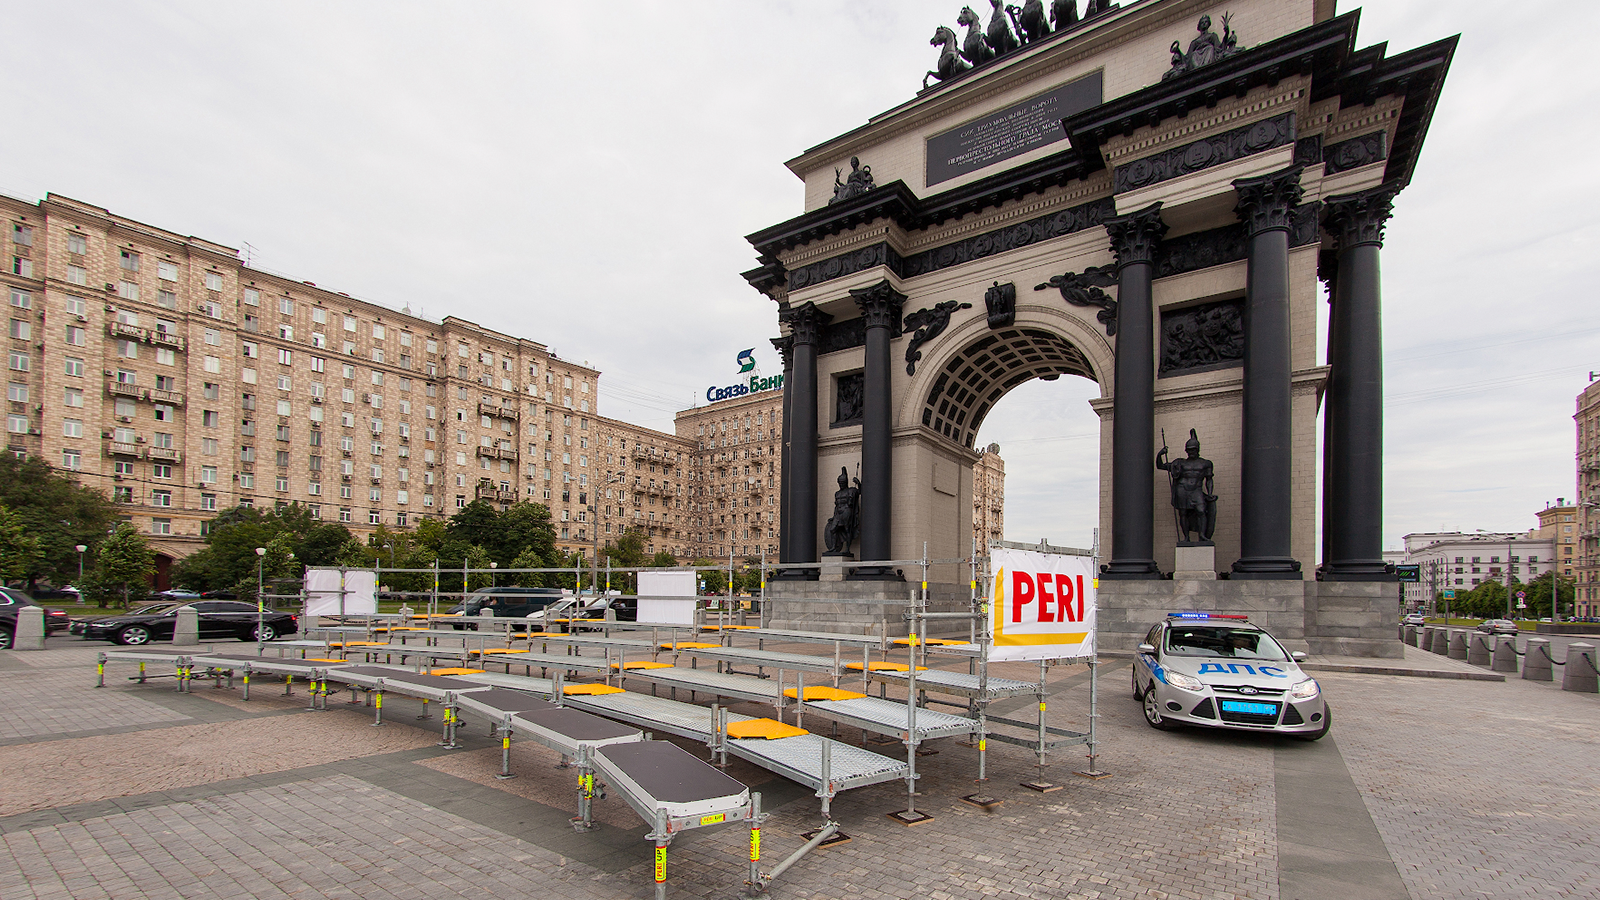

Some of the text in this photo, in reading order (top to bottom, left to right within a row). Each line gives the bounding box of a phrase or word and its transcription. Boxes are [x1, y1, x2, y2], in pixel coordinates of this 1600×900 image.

[1031, 97, 1058, 111] ВОРОТА
[1012, 571, 1084, 623] PERI
[1198, 663, 1288, 678] ДПС
[656, 849, 663, 861] UP
